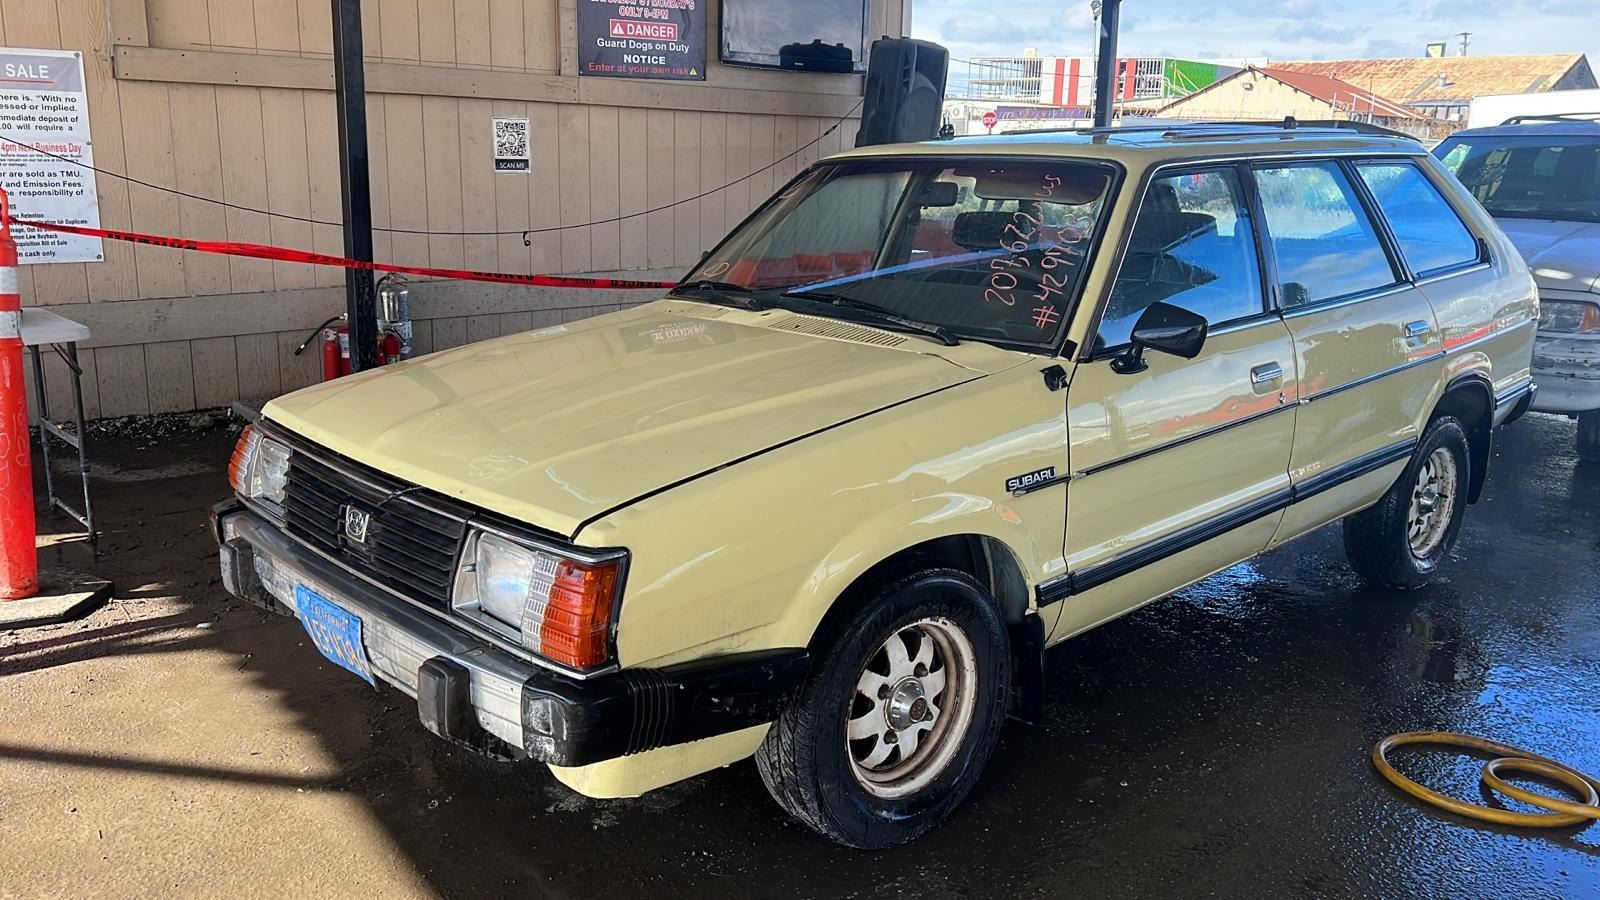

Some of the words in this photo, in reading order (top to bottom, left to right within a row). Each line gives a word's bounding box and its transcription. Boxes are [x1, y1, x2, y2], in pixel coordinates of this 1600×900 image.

[619, 6, 643, 18] ONLY
[644, 8, 669, 20] 9-4PM
[627, 24, 674, 38] DANGER
[597, 38, 627, 49] Guard
[629, 40, 653, 52] Dogs
[669, 42, 690, 54] Duty
[623, 54, 666, 65] NOTICE
[5, 63, 49, 79] SALE
[589, 62, 614, 72] Enter
[617, 65, 627, 73] at
[629, 67, 649, 76] your
[673, 67, 689, 75] risk
[22, 94, 33, 102] is.
[41, 104, 78, 112] implied.
[38, 115, 69, 123] deposit
[70, 115, 79, 123] of
[35, 124, 64, 132] require
[1, 142, 17, 155] 4pm
[36, 142, 68, 152] Business
[69, 142, 82, 155] Day
[25, 170, 45, 178] sold
[59, 170, 83, 178] TMU.
[5, 180, 21, 188] and
[23, 180, 61, 188] Emission
[19, 189, 73, 198] responsibility
[42, 249, 56, 258] only
[1008, 467, 1057, 491] SUBARU
